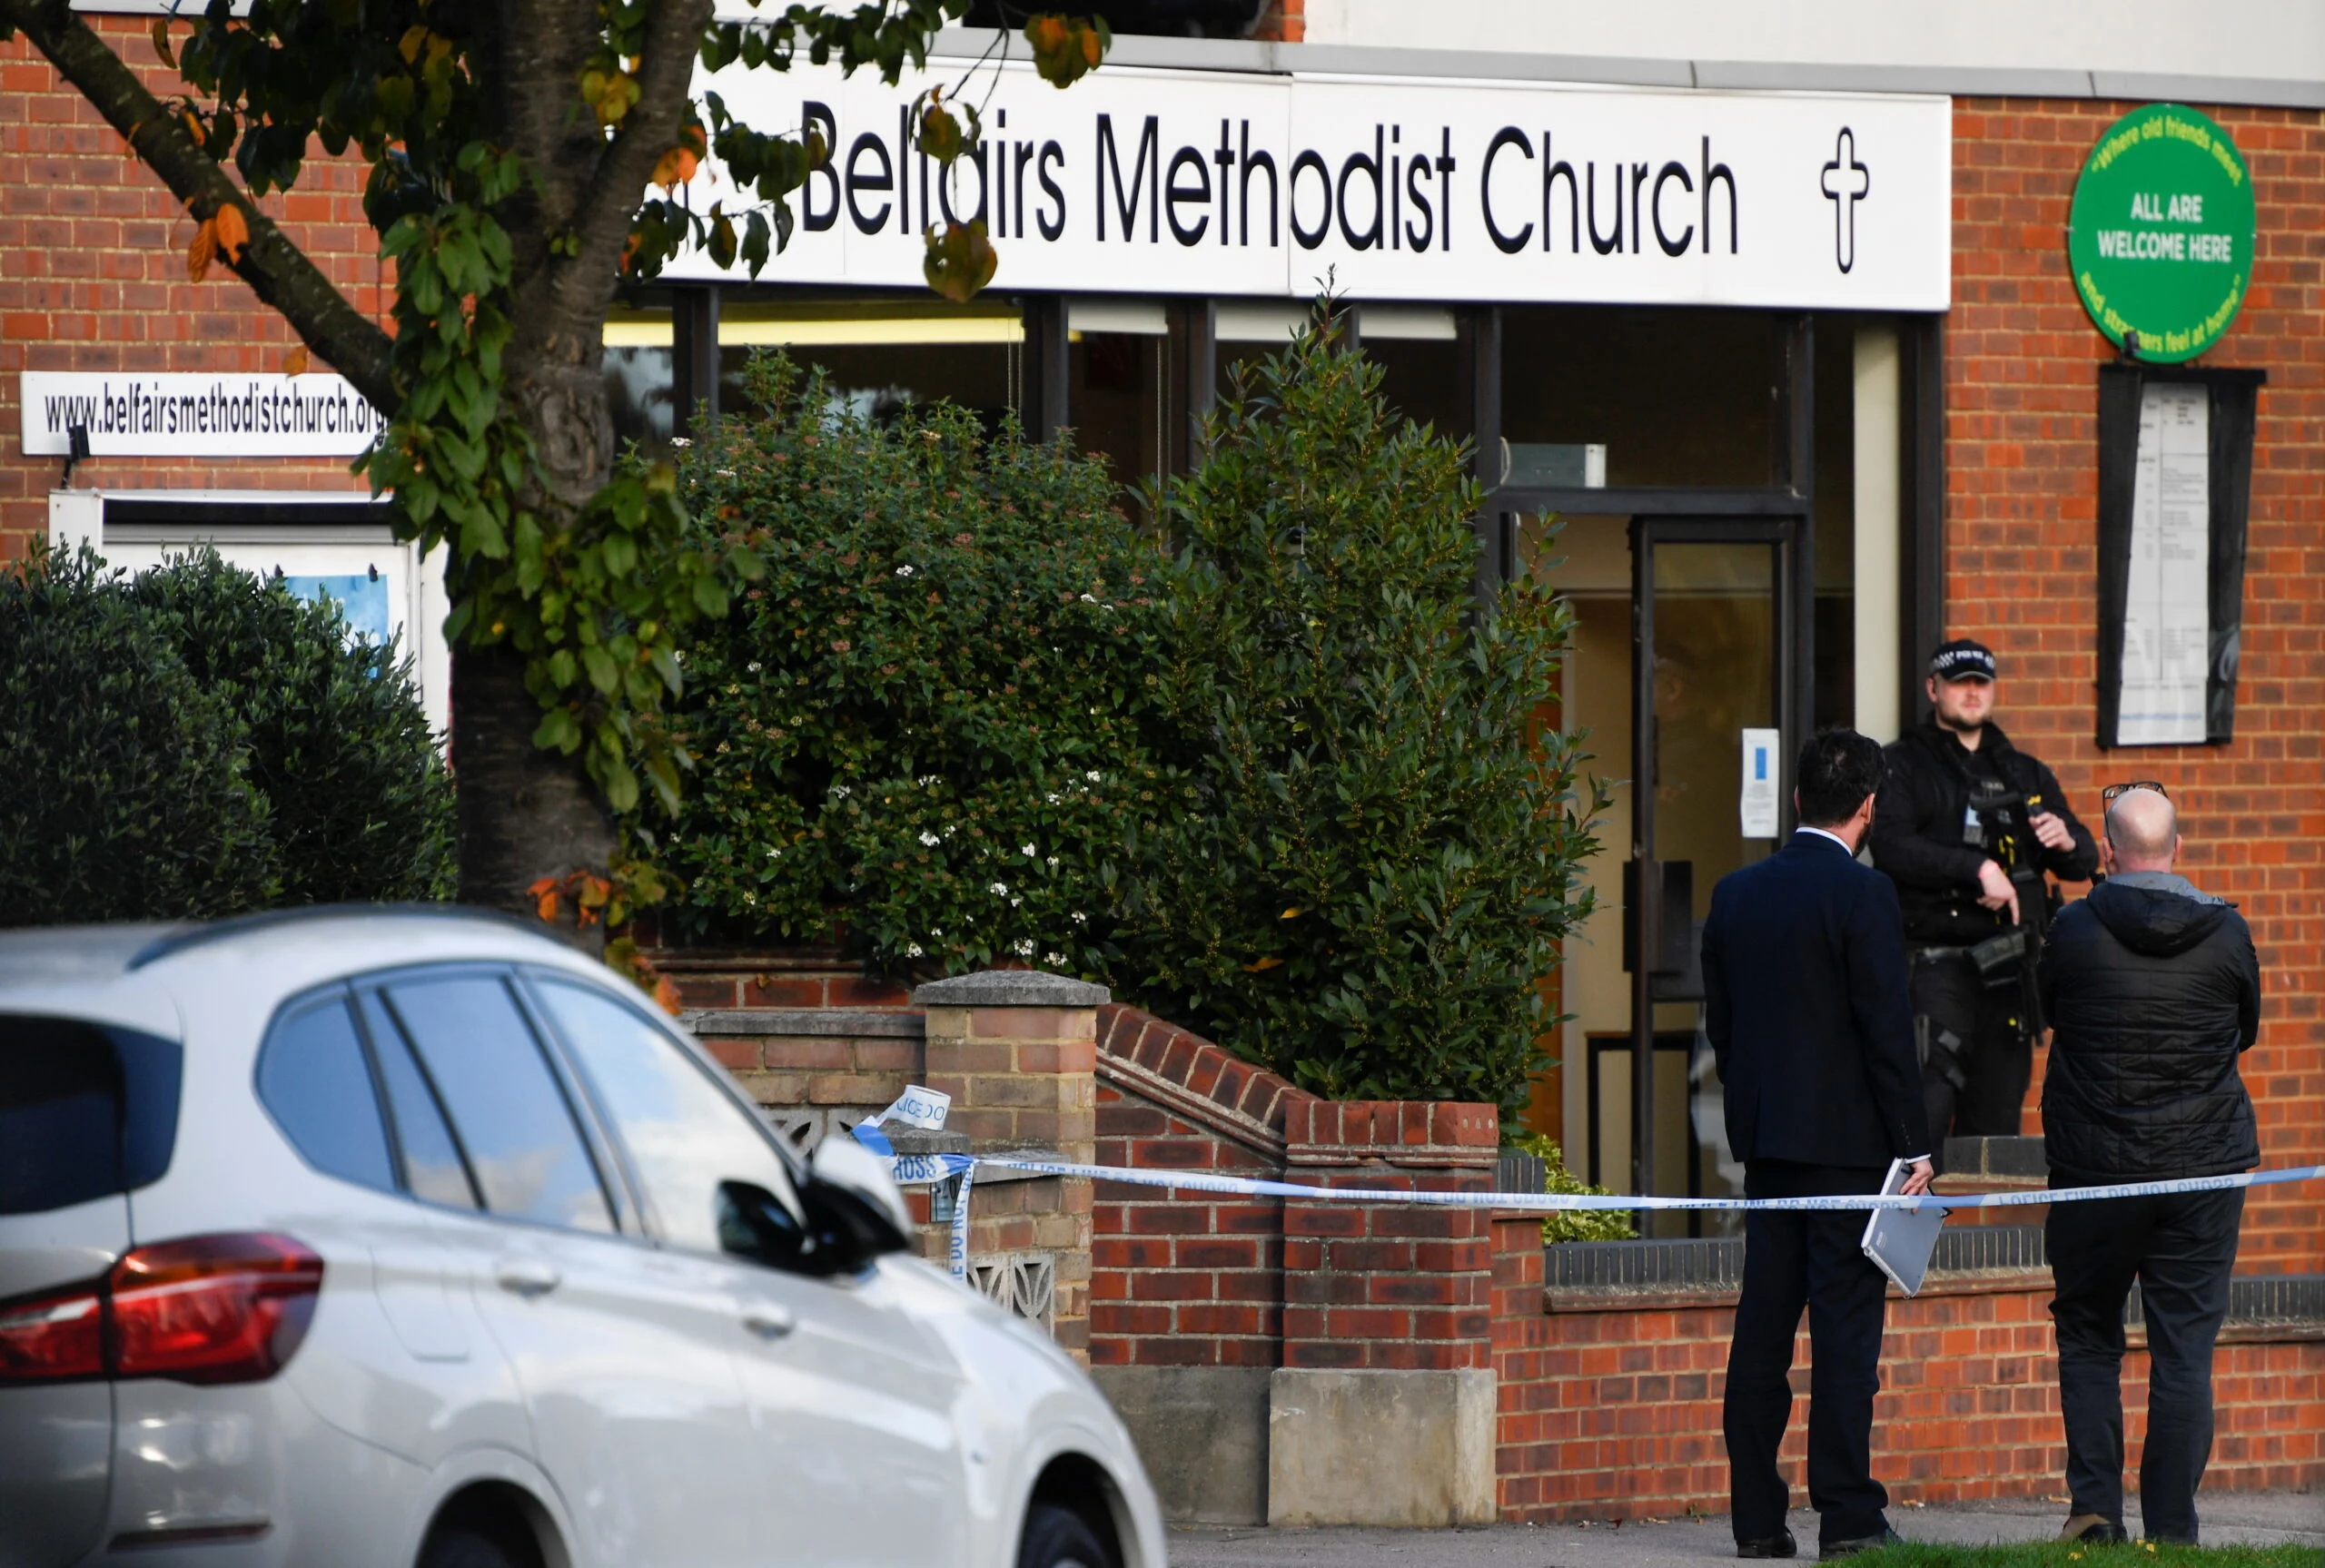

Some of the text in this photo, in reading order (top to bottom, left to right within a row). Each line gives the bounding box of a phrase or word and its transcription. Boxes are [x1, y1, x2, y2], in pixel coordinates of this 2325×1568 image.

[802, 100, 1738, 258] Belfairs Methodist Church
[2131, 192, 2202, 223] ALL ARE
[2097, 230, 2232, 262] WELCOME HERE
